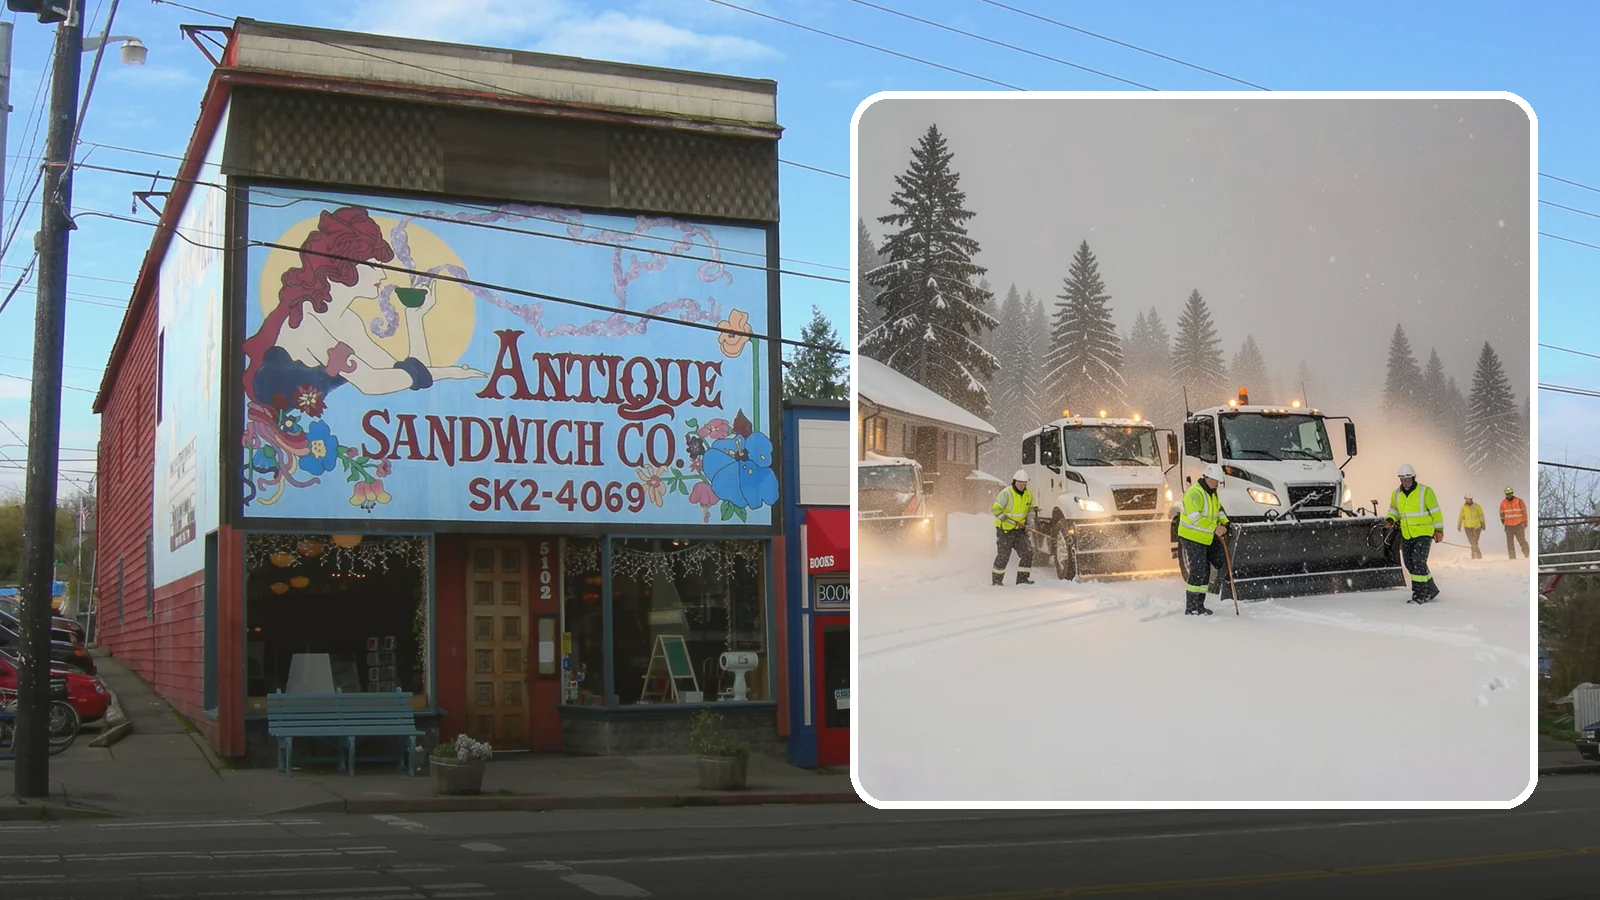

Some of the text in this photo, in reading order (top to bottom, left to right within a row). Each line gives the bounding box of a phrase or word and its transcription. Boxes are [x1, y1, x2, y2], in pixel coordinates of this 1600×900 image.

[476, 329, 723, 420] ANTIQUE
[361, 408, 685, 469] SANDWICH CO.
[468, 477, 645, 513] SK2-4069
[540, 541, 551, 600] 5102
[810, 555, 835, 569] BOOKS
